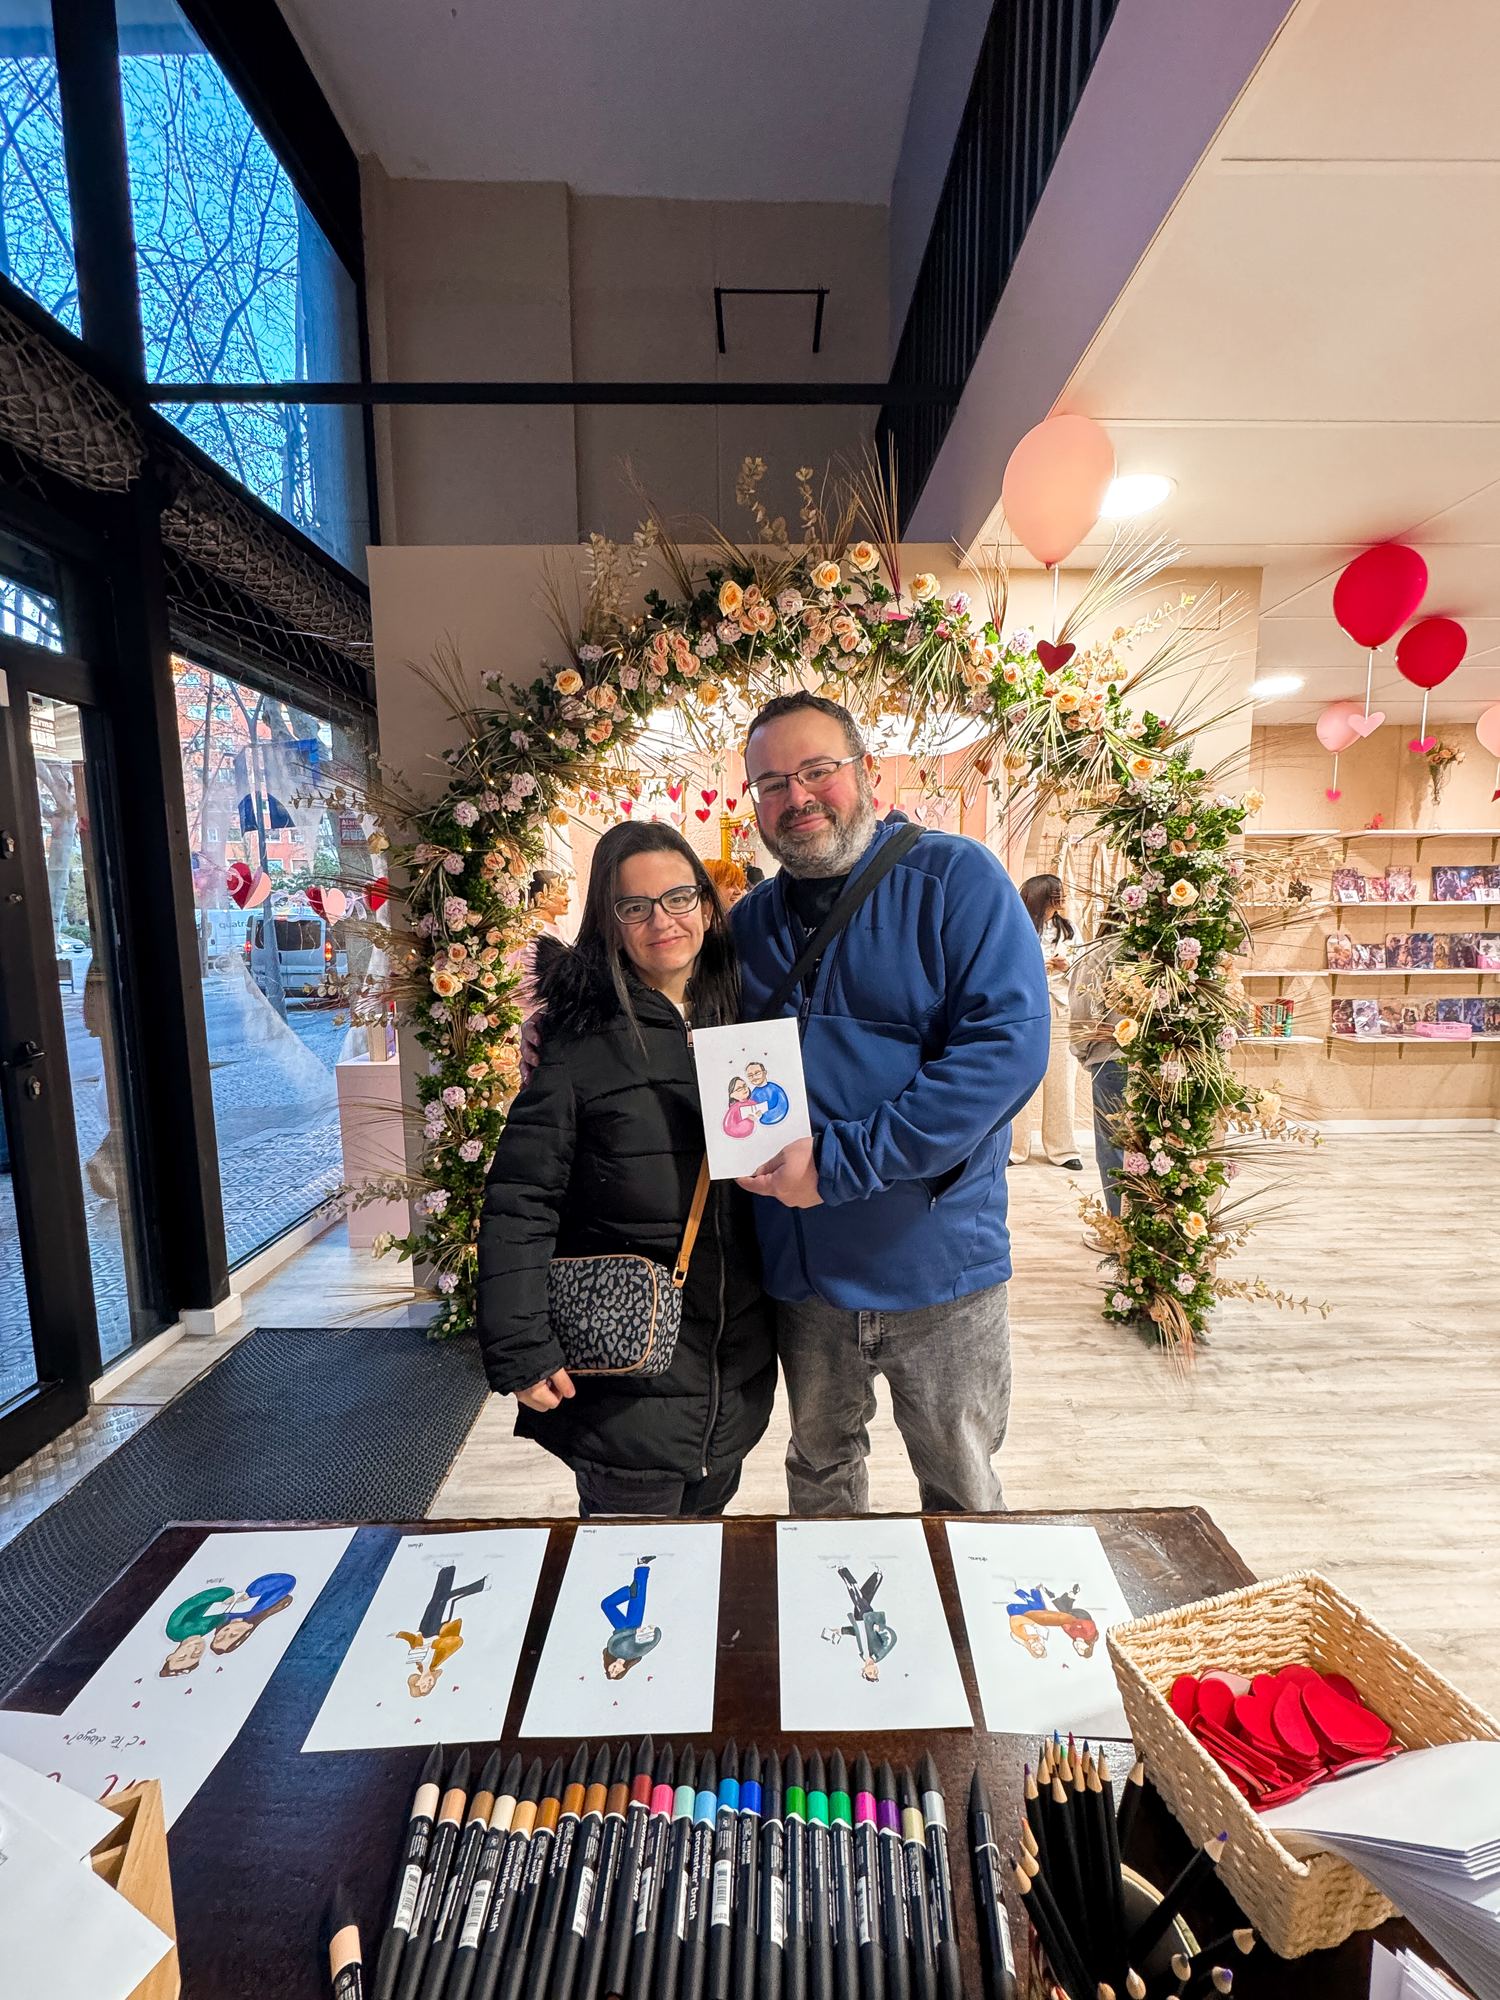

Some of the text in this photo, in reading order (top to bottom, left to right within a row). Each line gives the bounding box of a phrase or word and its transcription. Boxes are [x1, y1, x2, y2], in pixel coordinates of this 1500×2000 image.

[489, 1840, 517, 1933] promarker brush
[689, 1830, 702, 1920] promarker brush
